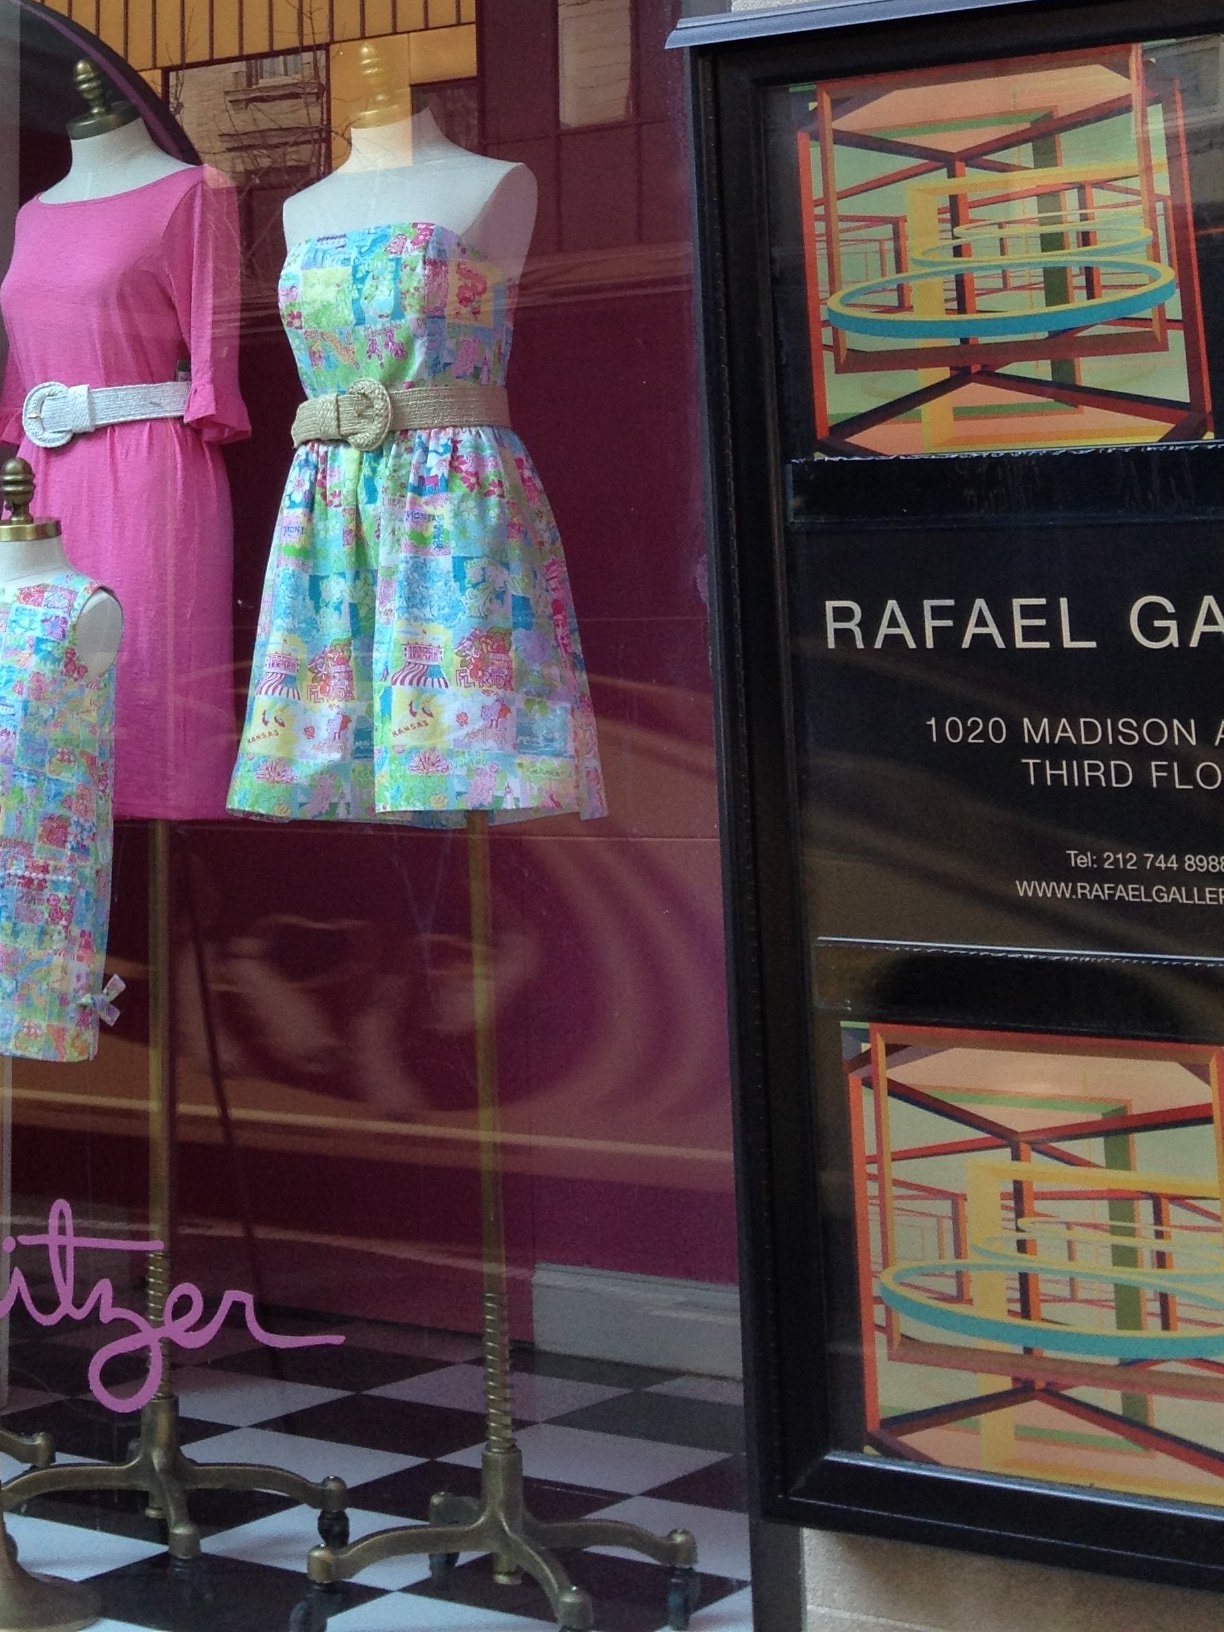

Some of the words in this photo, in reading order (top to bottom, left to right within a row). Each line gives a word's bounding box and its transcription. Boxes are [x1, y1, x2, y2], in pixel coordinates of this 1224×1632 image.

[824, 597, 1098, 649] RAFAEL
[1129, 595, 1224, 649] GA
[247, 729, 280, 745] KANSAS
[392, 719, 429, 738] KANSAS
[925, 716, 1007, 745] 1020
[1023, 718, 1197, 747] MADISON
[1021, 759, 1134, 788] THIRD
[1152, 760, 1224, 790] FLO
[1065, 850, 1099, 869] Tel:
[1103, 852, 1137, 870] 212
[1144, 853, 1179, 872] 744
